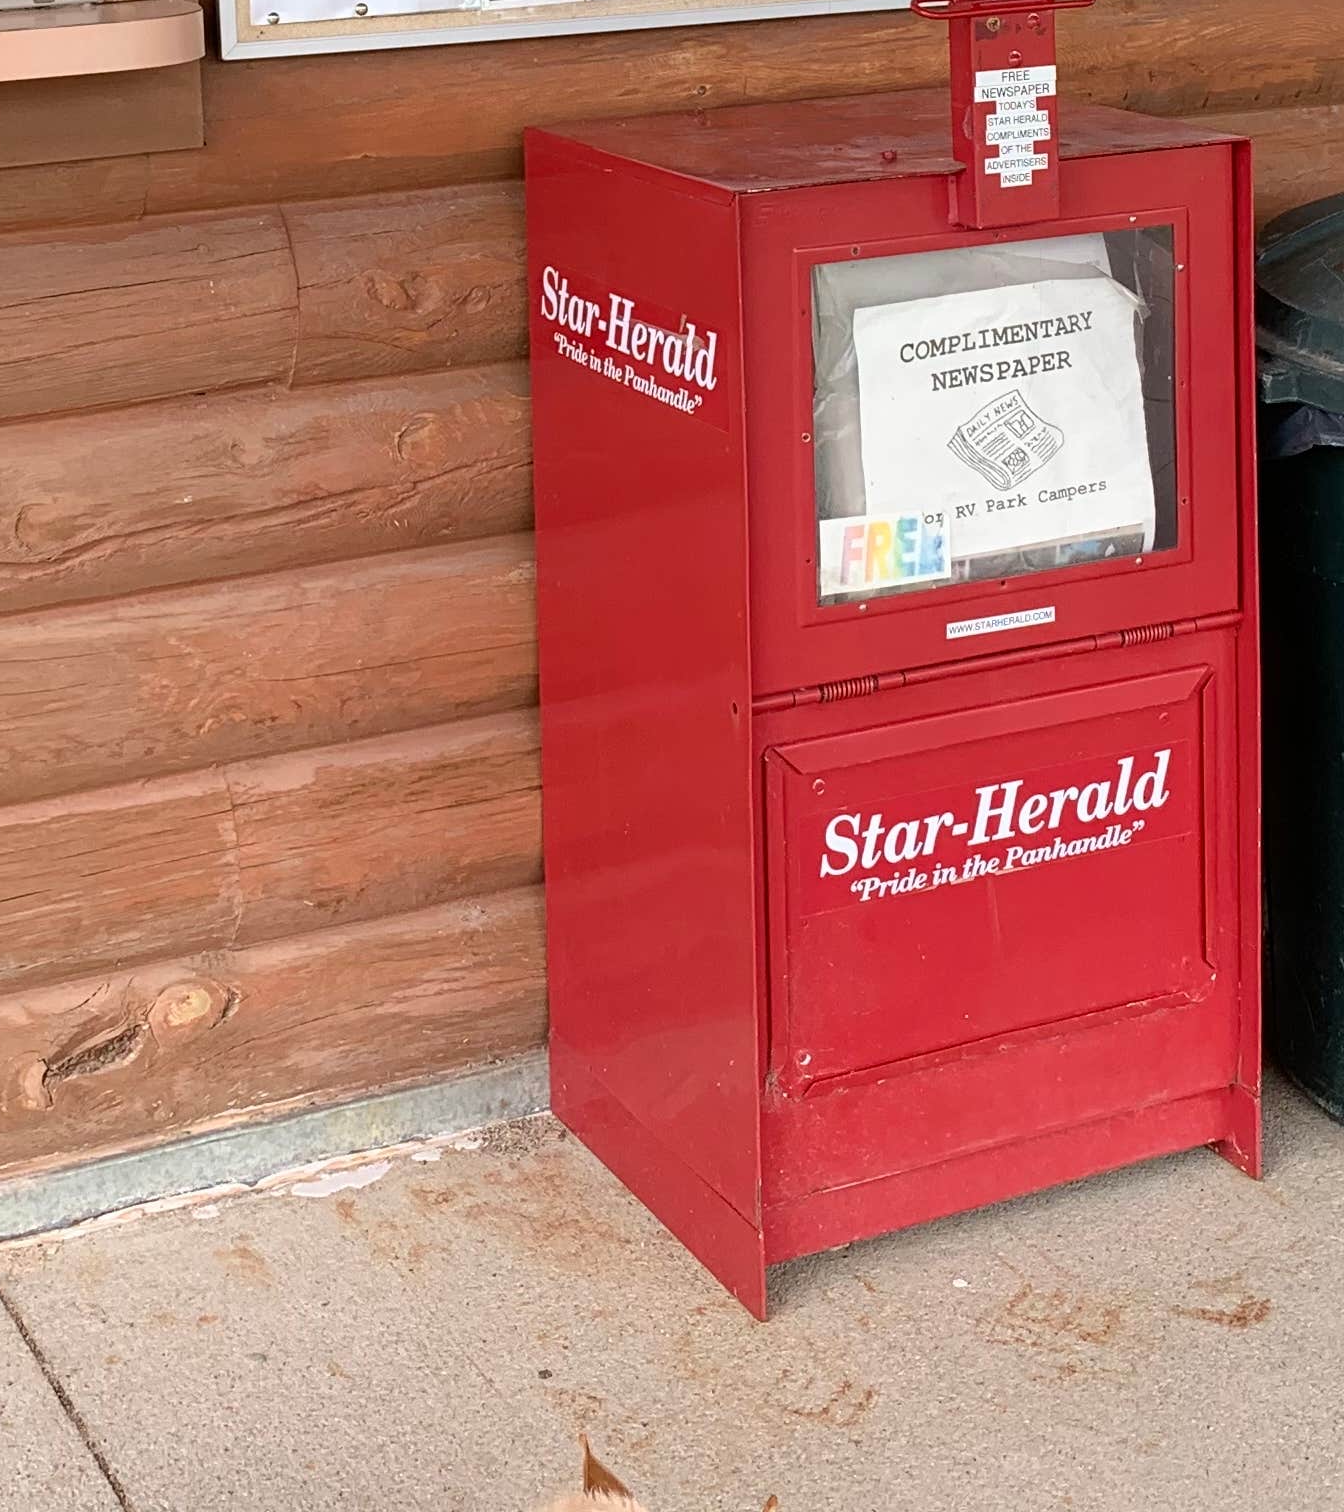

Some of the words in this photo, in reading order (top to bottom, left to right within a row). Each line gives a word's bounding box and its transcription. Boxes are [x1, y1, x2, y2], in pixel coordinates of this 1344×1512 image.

[1002, 70, 1030, 82] FREE
[982, 83, 1049, 99] NEWSPAPER
[999, 100, 1035, 110] TODAY'S
[988, 117, 1010, 126] STAR
[1014, 114, 1047, 124] HERALD
[987, 128, 1048, 141] COMPLIMENTS
[1001, 146, 1013, 154] OF
[1016, 144, 1032, 152] THE
[987, 157, 1046, 170] ADVERTISERS
[1003, 173, 1030, 183] INSIDE
[541, 266, 717, 390] Star-Herald
[900, 311, 1092, 363] COMPLIMENTARY
[554, 332, 587, 366] “Pride
[590, 349, 601, 373] in
[604, 358, 621, 382] the
[624, 365, 702, 414] Panhandle”
[932, 351, 1072, 391] NEWSPAPER
[967, 413, 990, 437] DAILY
[995, 396, 1018, 415] NEWS
[922, 512, 944, 527] or
[956, 504, 976, 519] RV
[986, 494, 1027, 512] Park
[1038, 480, 1106, 505] Campers
[948, 610, 1052, 636] WWW.STARHERALD.COM
[820, 749, 1171, 878] Star-Herald
[850, 871, 927, 902] “Pride
[933, 864, 957, 885] in
[963, 854, 999, 879] the
[1006, 820, 1145, 870] Panhandle”
